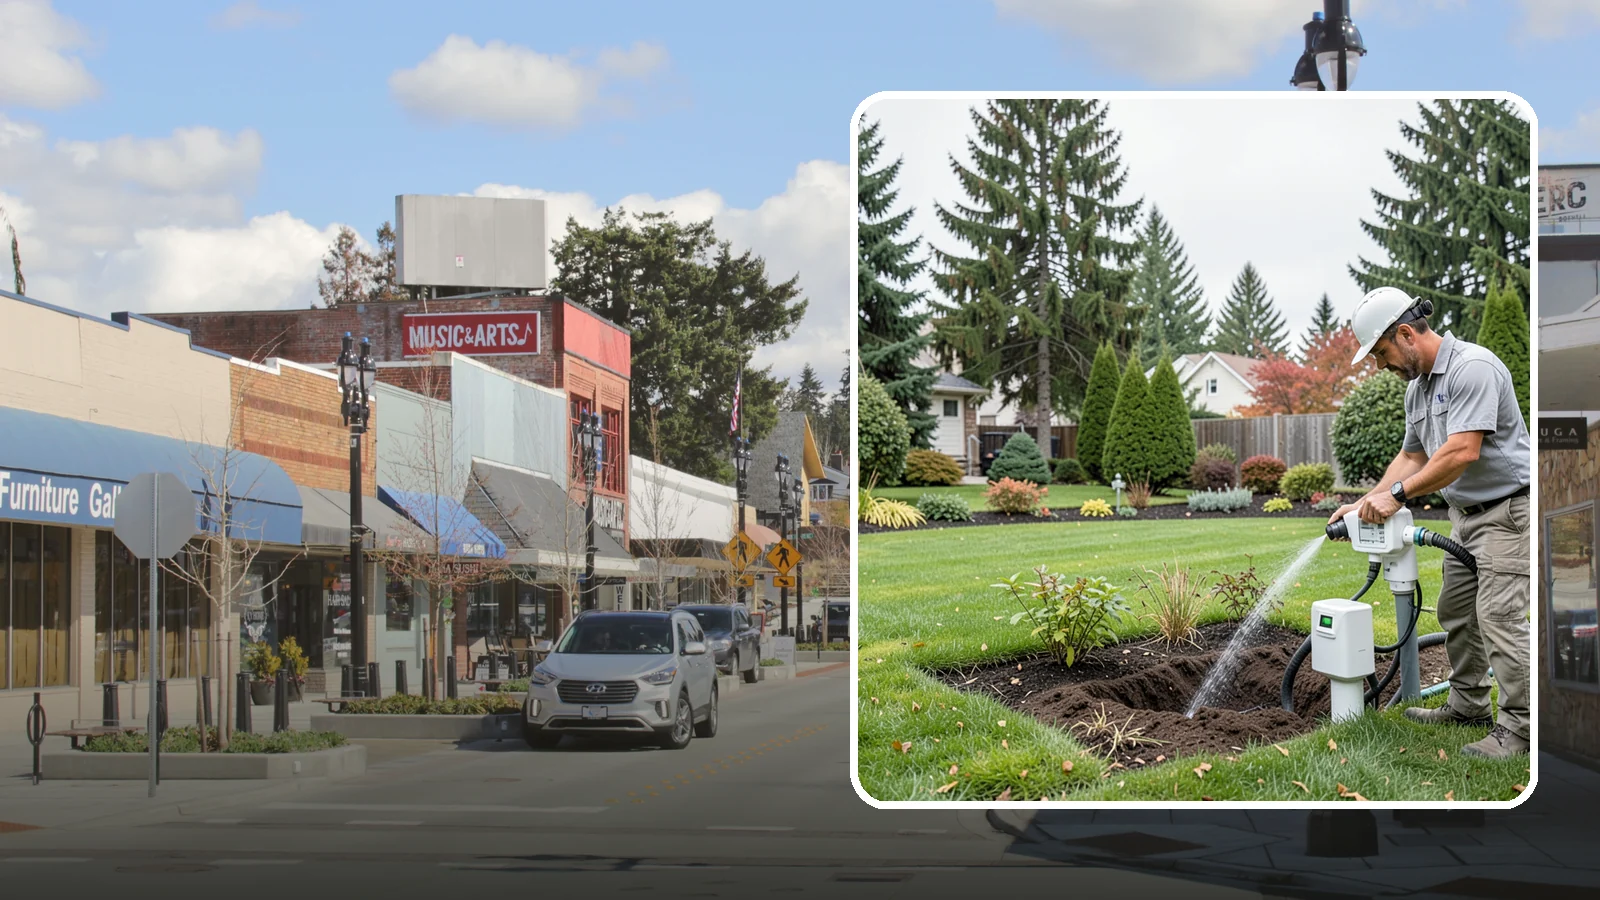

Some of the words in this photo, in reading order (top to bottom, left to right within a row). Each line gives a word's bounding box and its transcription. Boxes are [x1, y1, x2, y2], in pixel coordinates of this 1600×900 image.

[1540, 427, 1577, 436] UGA
[0, 471, 79, 515] Furniture
[89, 482, 122, 519] Gal
